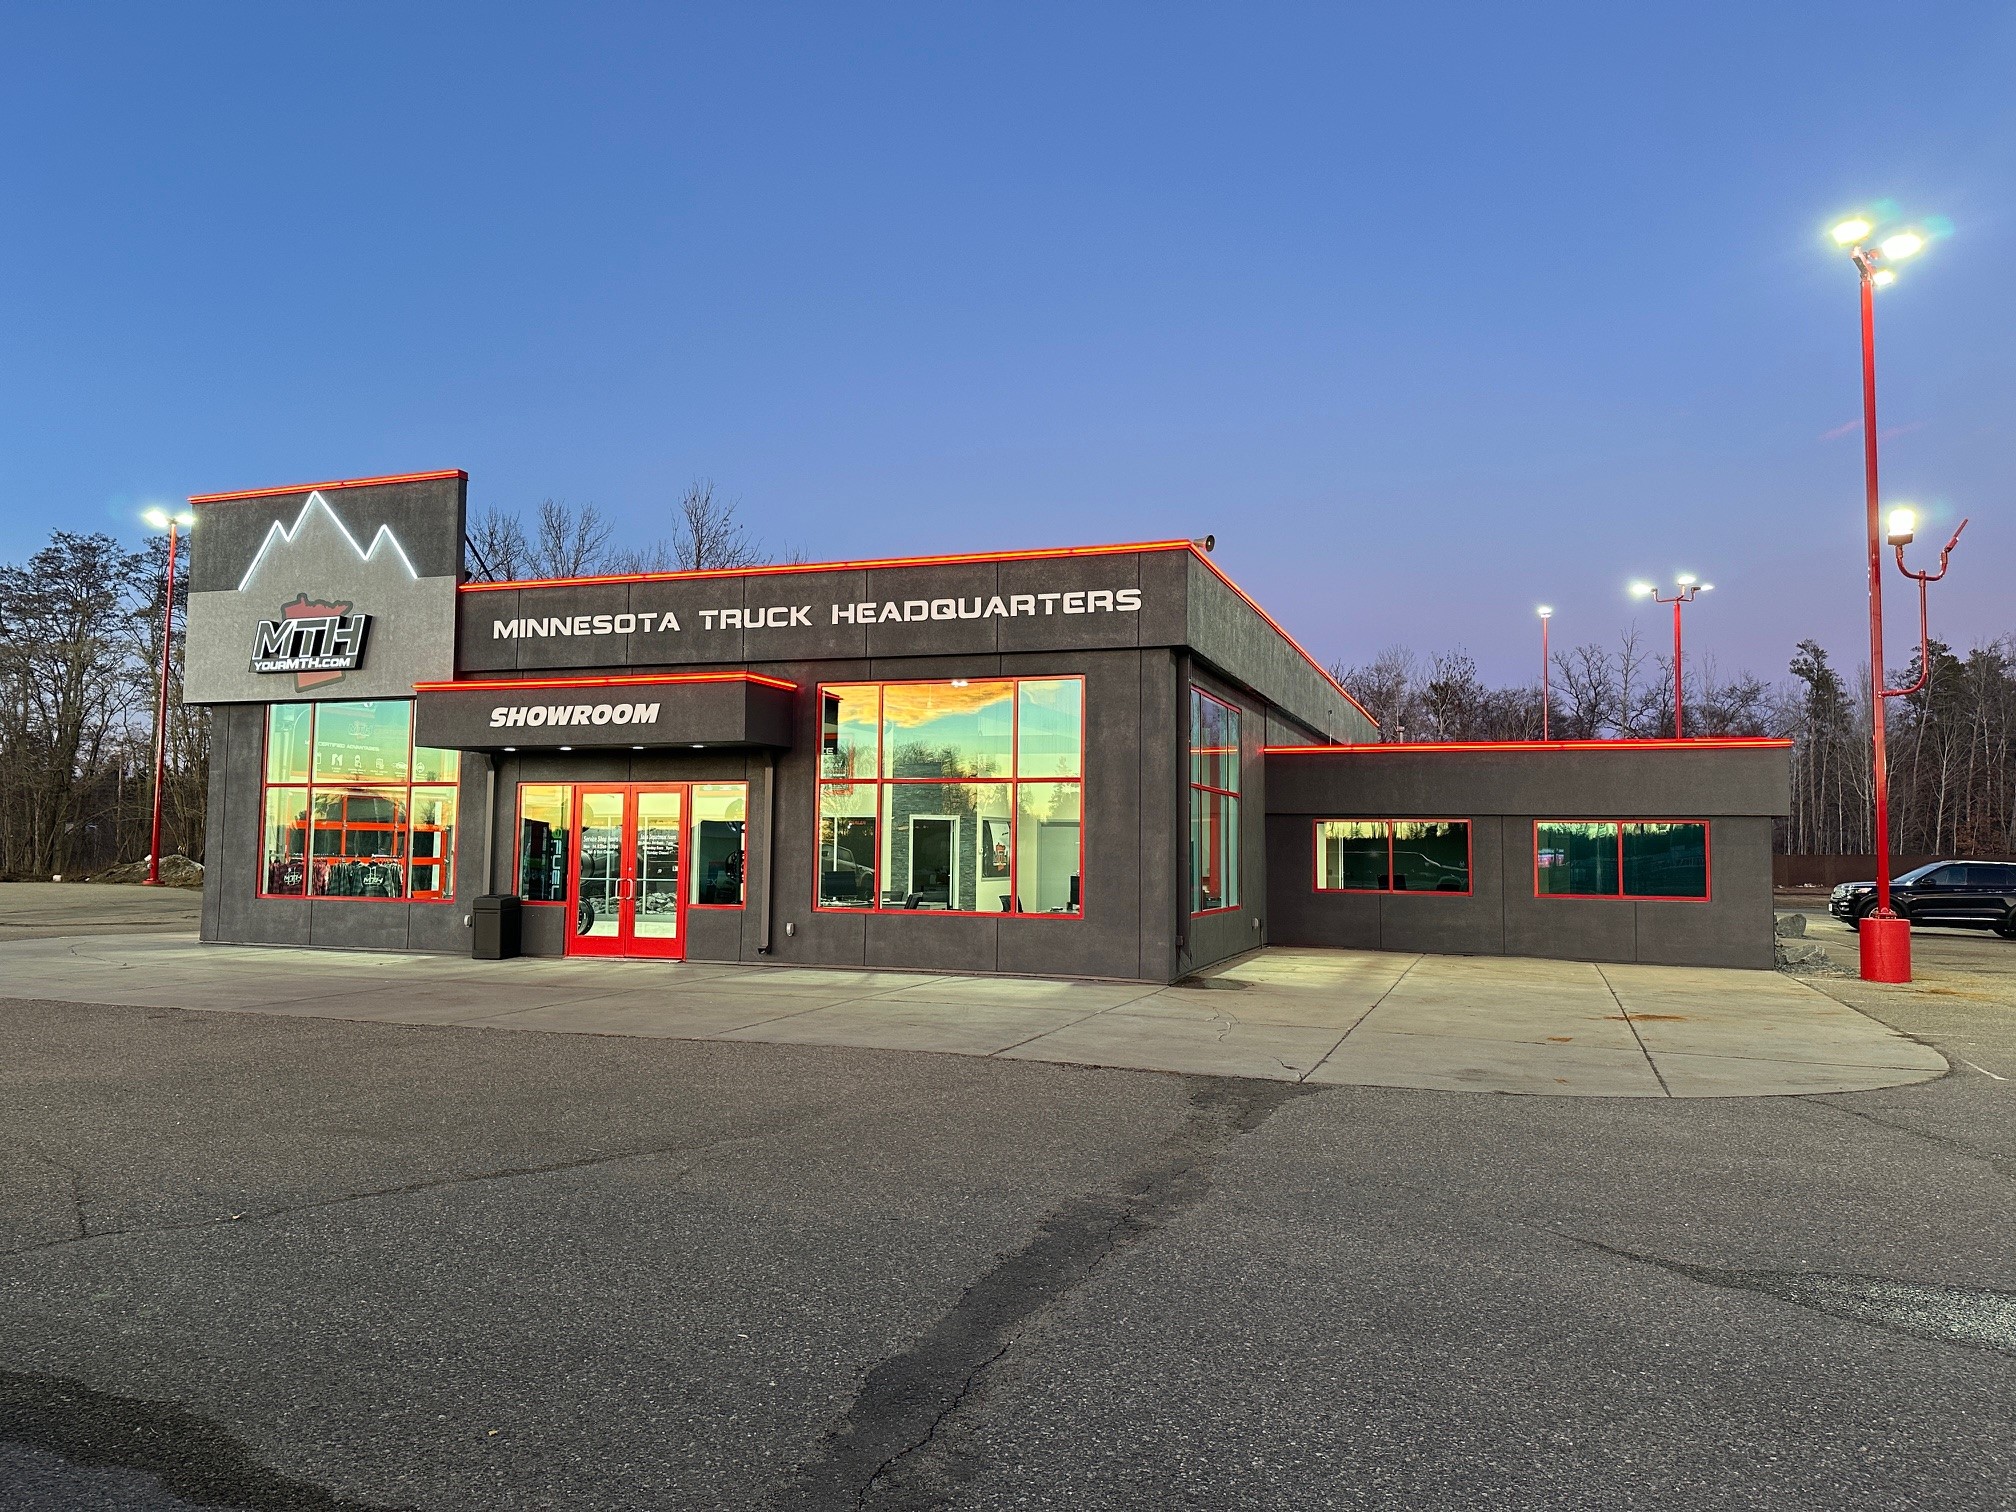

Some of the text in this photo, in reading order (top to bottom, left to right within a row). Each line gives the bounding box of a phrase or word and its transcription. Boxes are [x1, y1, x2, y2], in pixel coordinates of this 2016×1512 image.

[252, 614, 366, 660] MTH
[493, 589, 1142, 639] MINNESOTA TRUCK HEADQUARTERS
[254, 657, 351, 671] YOURMTH.COM
[489, 703, 661, 728] SHOWROOM
[551, 839, 562, 900] FUEL
